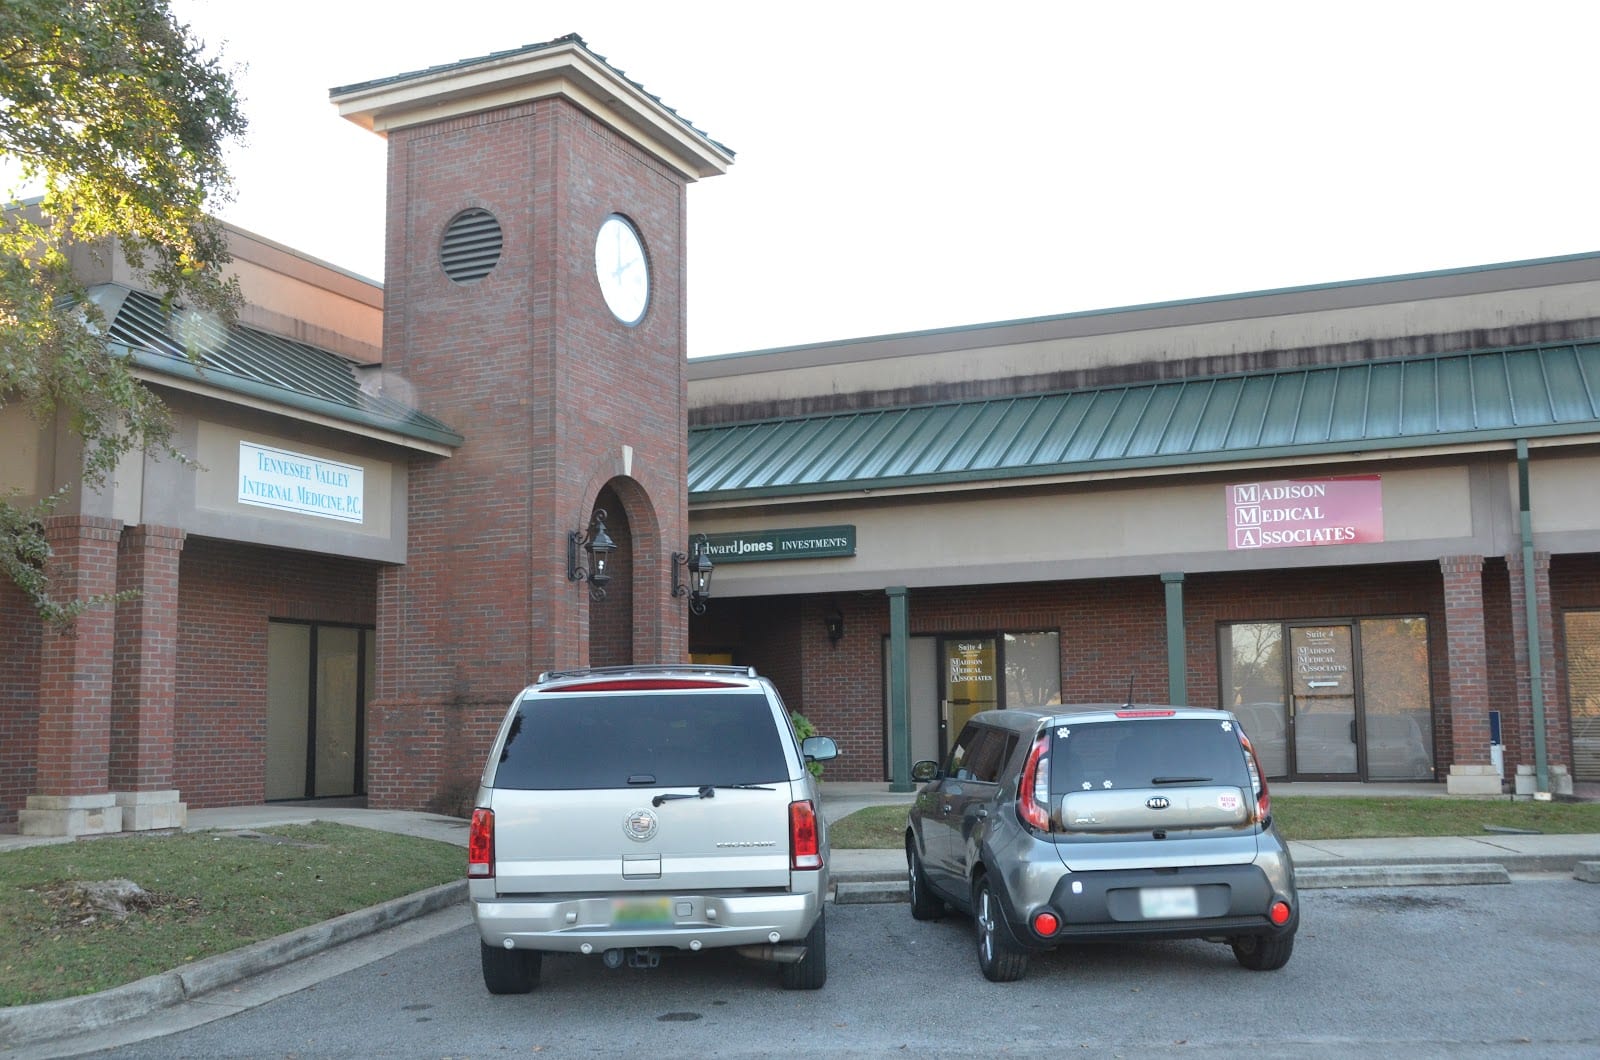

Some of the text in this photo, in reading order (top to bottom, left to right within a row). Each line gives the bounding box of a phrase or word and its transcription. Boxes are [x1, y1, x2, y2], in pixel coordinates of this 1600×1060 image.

[257, 451, 350, 488] TENNESSEE VALLEY
[242, 475, 293, 501] INTERNAL
[1237, 484, 1326, 503] MADISON
[1238, 506, 1325, 524] MEDICAL
[1241, 526, 1355, 546] ASSOCIATES
[781, 537, 848, 550] INVESTMENTS
[1306, 630, 1327, 638] Suite
[1299, 647, 1336, 656] MADISON
[1301, 664, 1347, 673] ASSOCIATES
[1149, 798, 1167, 808] KIA
[716, 840, 776, 849] ESCALADE
